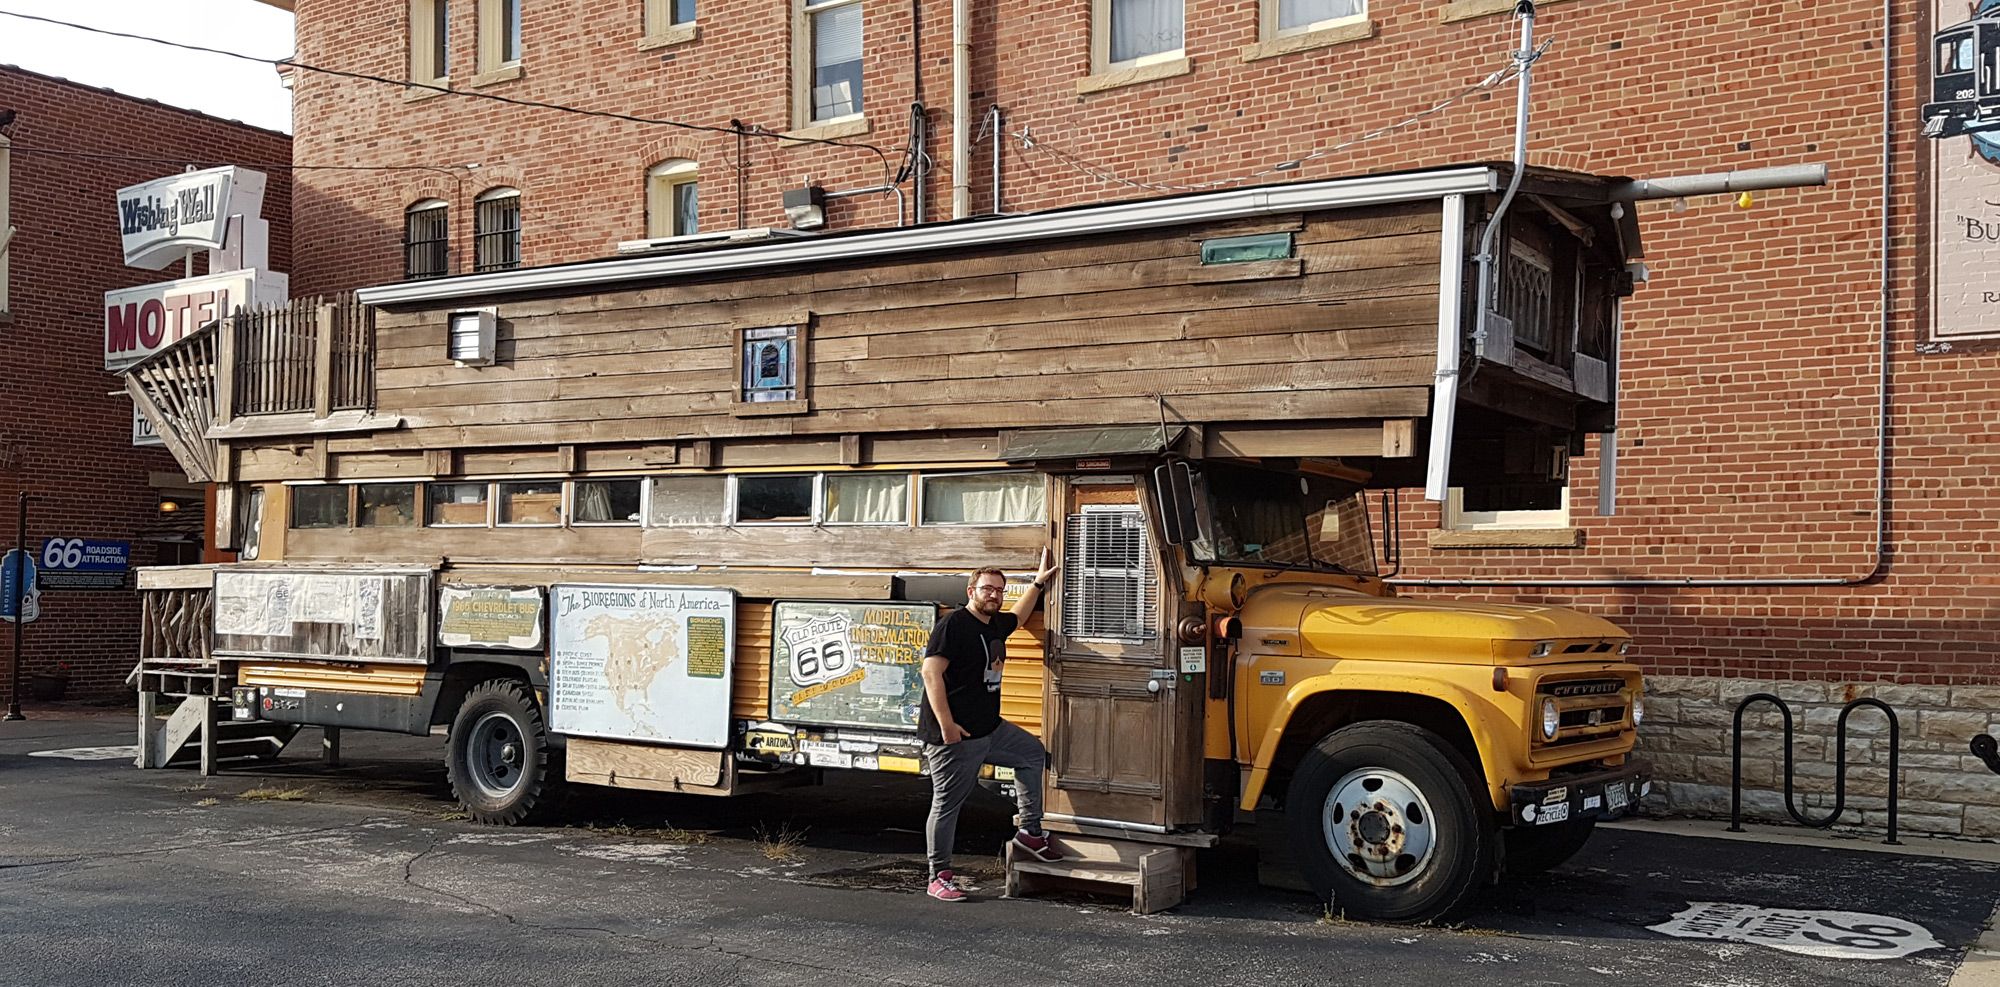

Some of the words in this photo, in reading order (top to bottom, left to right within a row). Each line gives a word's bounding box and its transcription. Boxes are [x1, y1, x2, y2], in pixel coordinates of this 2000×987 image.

[1956, 89, 1975, 99] 202
[121, 195, 178, 236] Wishing
[178, 184, 215, 226] Well
[44, 538, 84, 568] 66
[81, 555, 127, 564] ATTRACTION
[86, 546, 122, 555] ROADSIDE
[3, 570, 11, 613] DIRECTORY
[472, 601, 518, 614] CHEVROLET
[520, 603, 536, 615] BUS
[561, 594, 581, 616] The
[582, 591, 636, 610] BIOREGIONS
[648, 592, 675, 610] North
[677, 592, 721, 613] America
[863, 608, 912, 625] MOBILE
[792, 630, 809, 643] OLD
[811, 619, 842, 636] ROUTE
[798, 640, 844, 677] 66
[860, 646, 914, 664] CENTER
[1554, 684, 1617, 695] CHEVROLET
[1537, 807, 1562, 823] RECYCLE
[1747, 913, 1811, 940] ROUTE
[1802, 918, 1912, 949] 66
